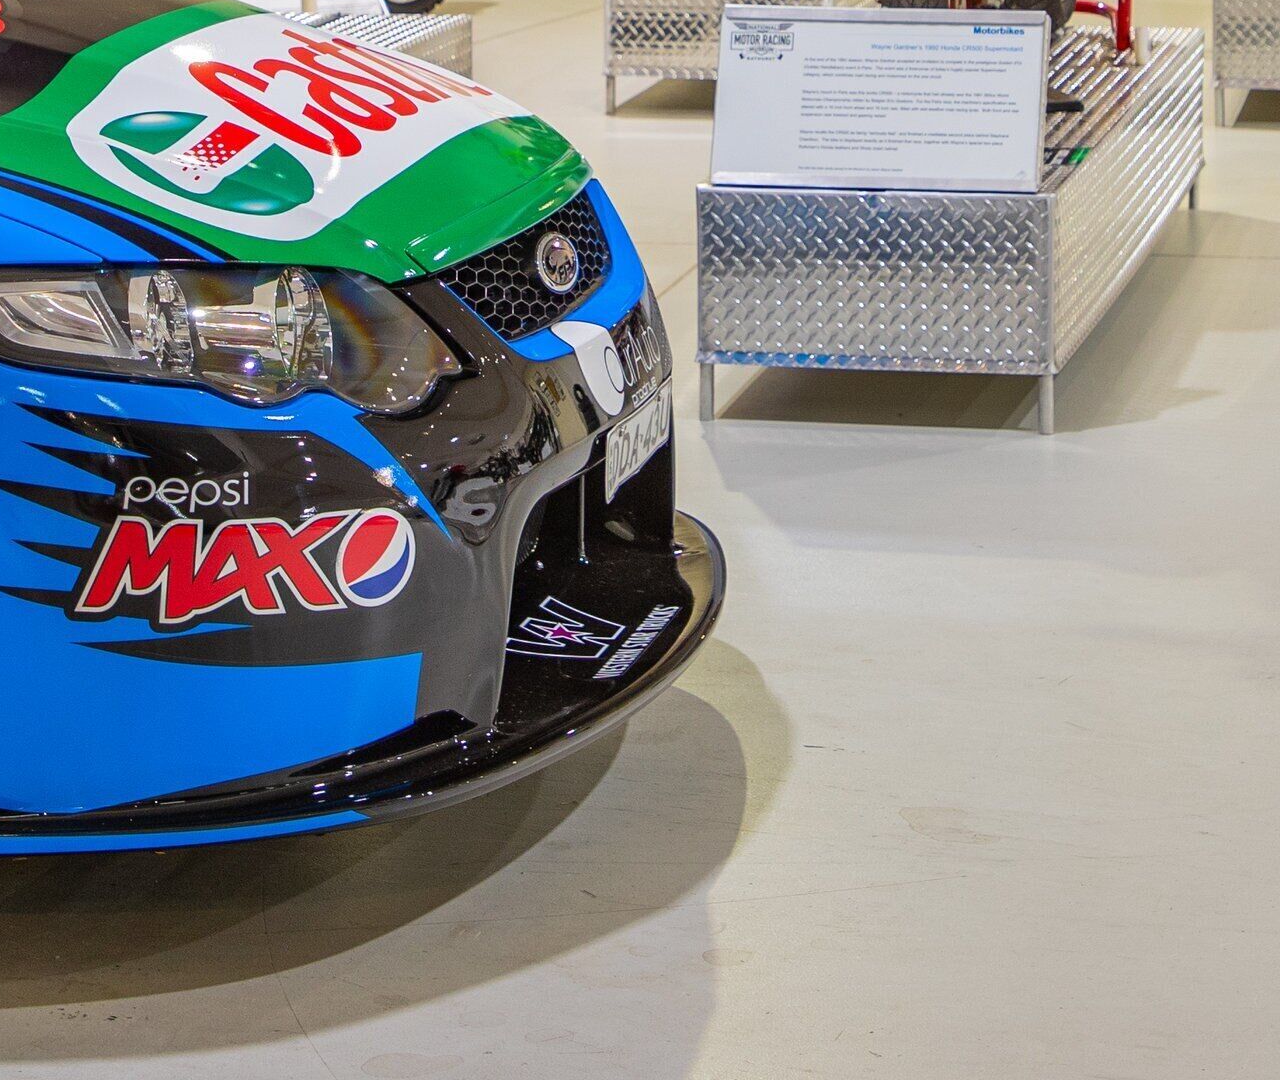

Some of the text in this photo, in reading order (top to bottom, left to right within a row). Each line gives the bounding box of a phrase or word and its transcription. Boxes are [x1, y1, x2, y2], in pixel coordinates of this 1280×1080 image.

[734, 34, 792, 46] MOTOR RACING
[973, 26, 1025, 36] Motorbikes
[123, 471, 250, 512] pepsi
[74, 509, 364, 623] MAX
[592, 646, 645, 679] WESTERN
[621, 630, 659, 649] STAR
